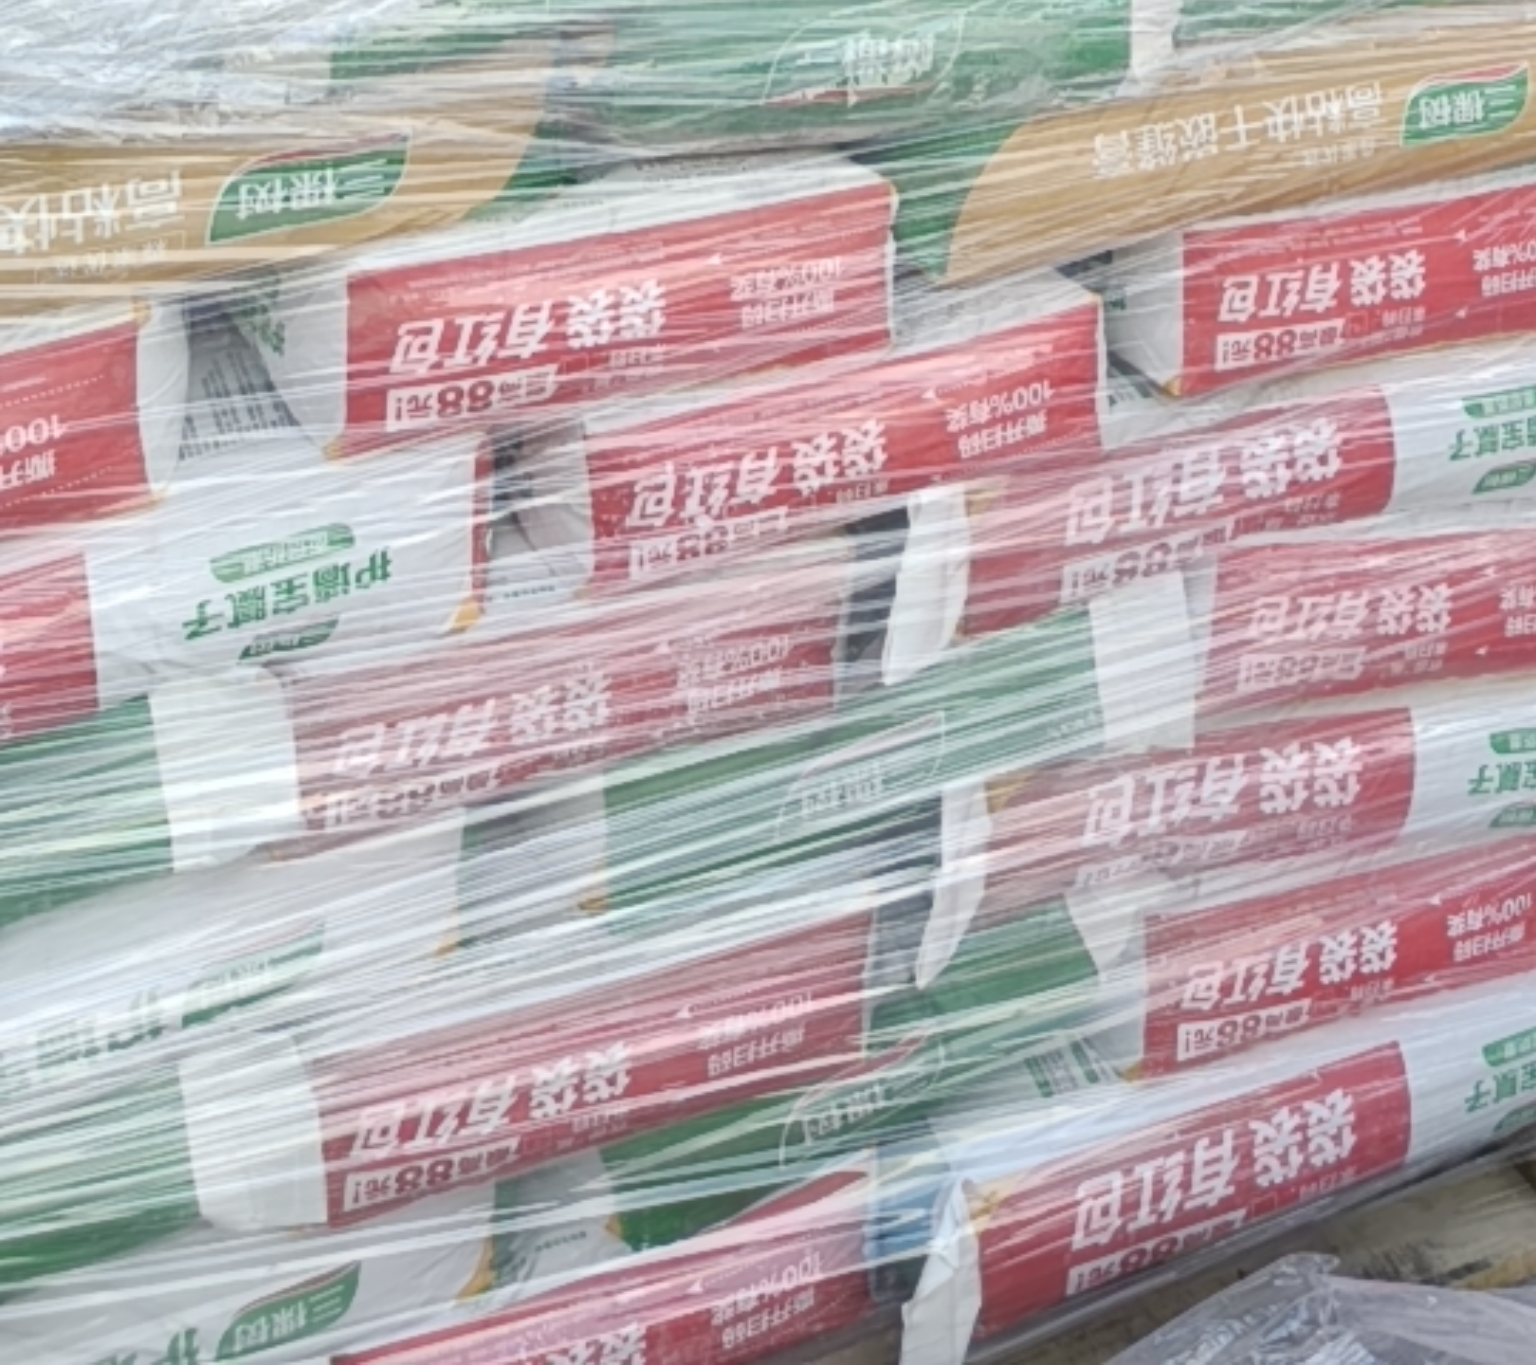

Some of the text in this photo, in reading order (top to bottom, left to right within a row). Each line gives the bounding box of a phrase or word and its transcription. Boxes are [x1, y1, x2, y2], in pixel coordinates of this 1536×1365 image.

[1421, 85, 1518, 130] 三棵树
[390, 279, 665, 374] 袋袋有红包
[1217, 248, 1427, 323] 袋袋有红包
[1069, 1090, 1357, 1252] 袋袋有红包
